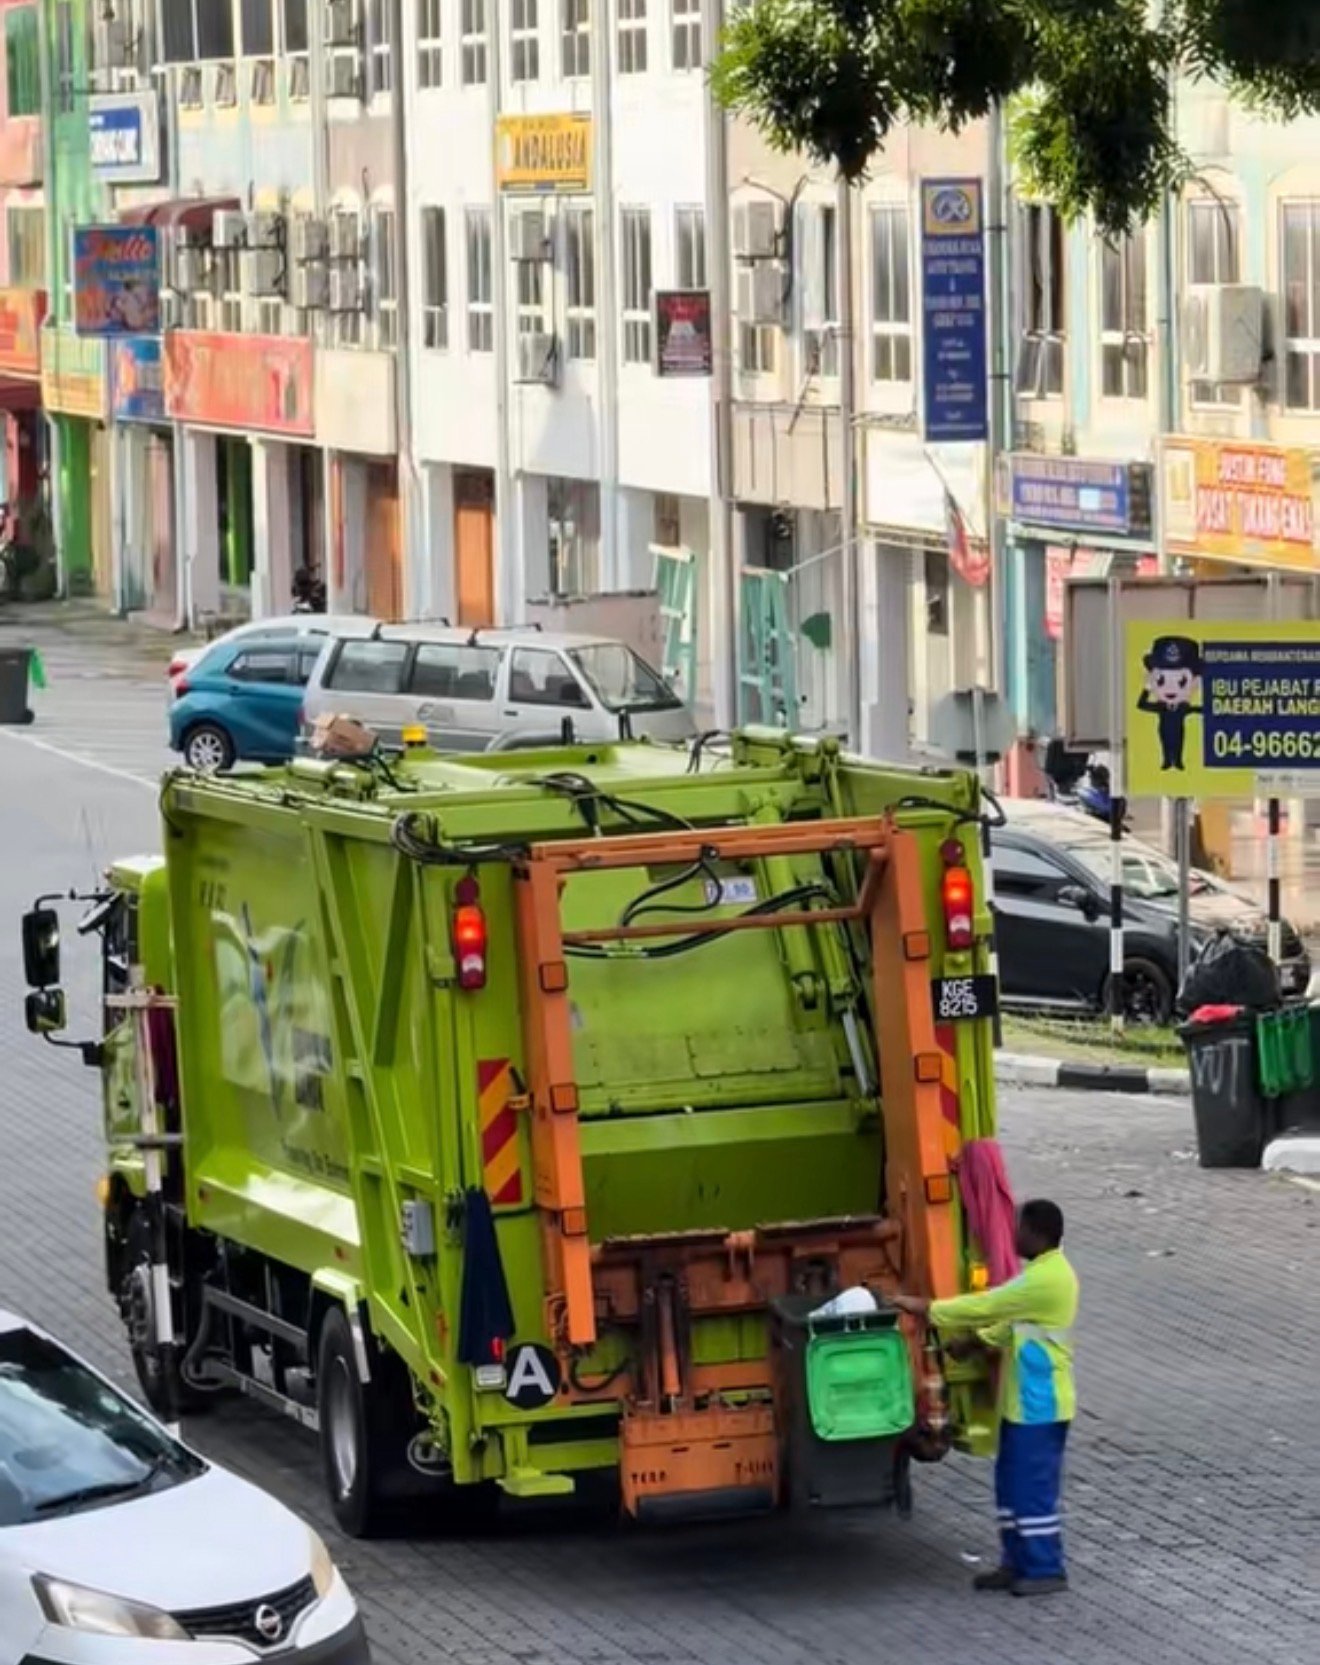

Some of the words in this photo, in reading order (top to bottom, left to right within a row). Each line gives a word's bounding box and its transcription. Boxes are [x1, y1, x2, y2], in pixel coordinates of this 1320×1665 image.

[1212, 679, 1238, 696] IBU
[1241, 679, 1310, 696] PEJABAT
[1212, 698, 1274, 715] DAERAH
[506, 1346, 555, 1397] A
